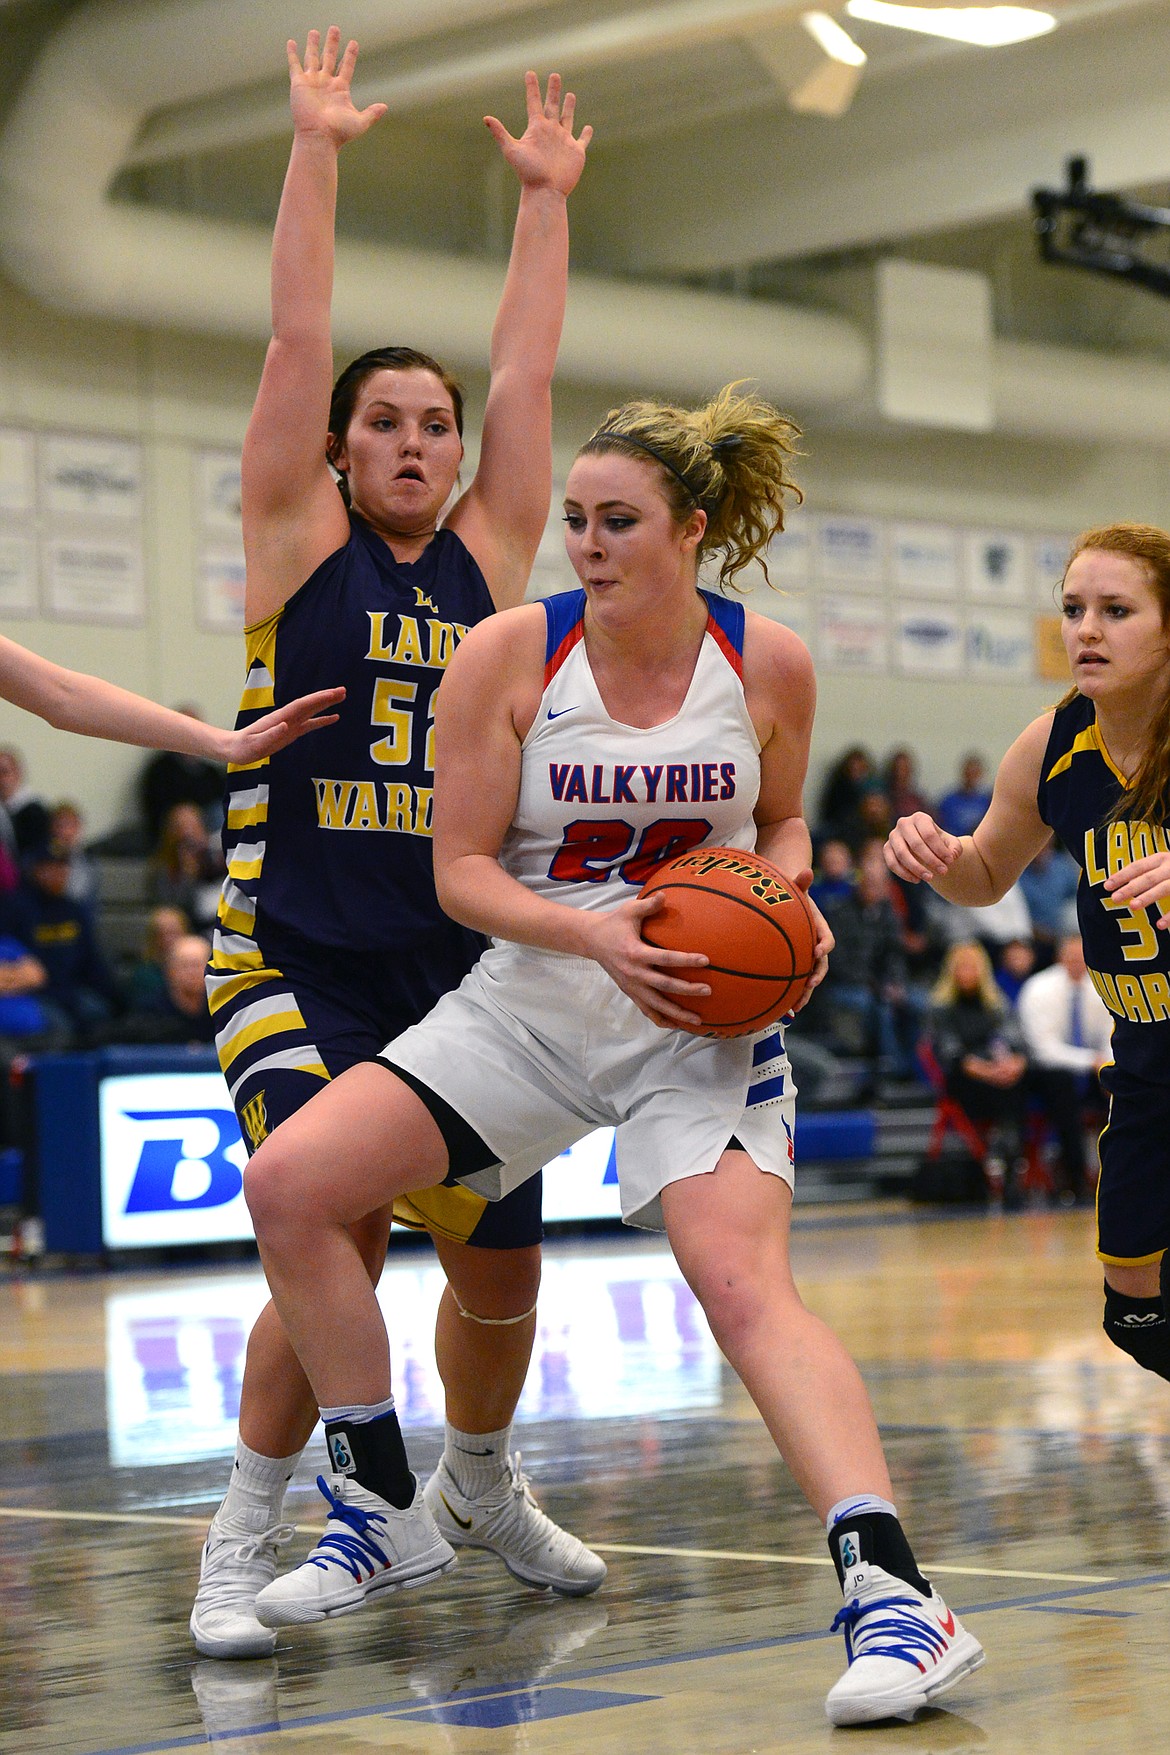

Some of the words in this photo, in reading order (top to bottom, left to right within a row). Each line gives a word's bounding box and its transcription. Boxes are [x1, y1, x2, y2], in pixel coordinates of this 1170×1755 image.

[369, 676, 439, 772] 5
[548, 762, 737, 804] VALKYRIES
[546, 817, 714, 887] 20
